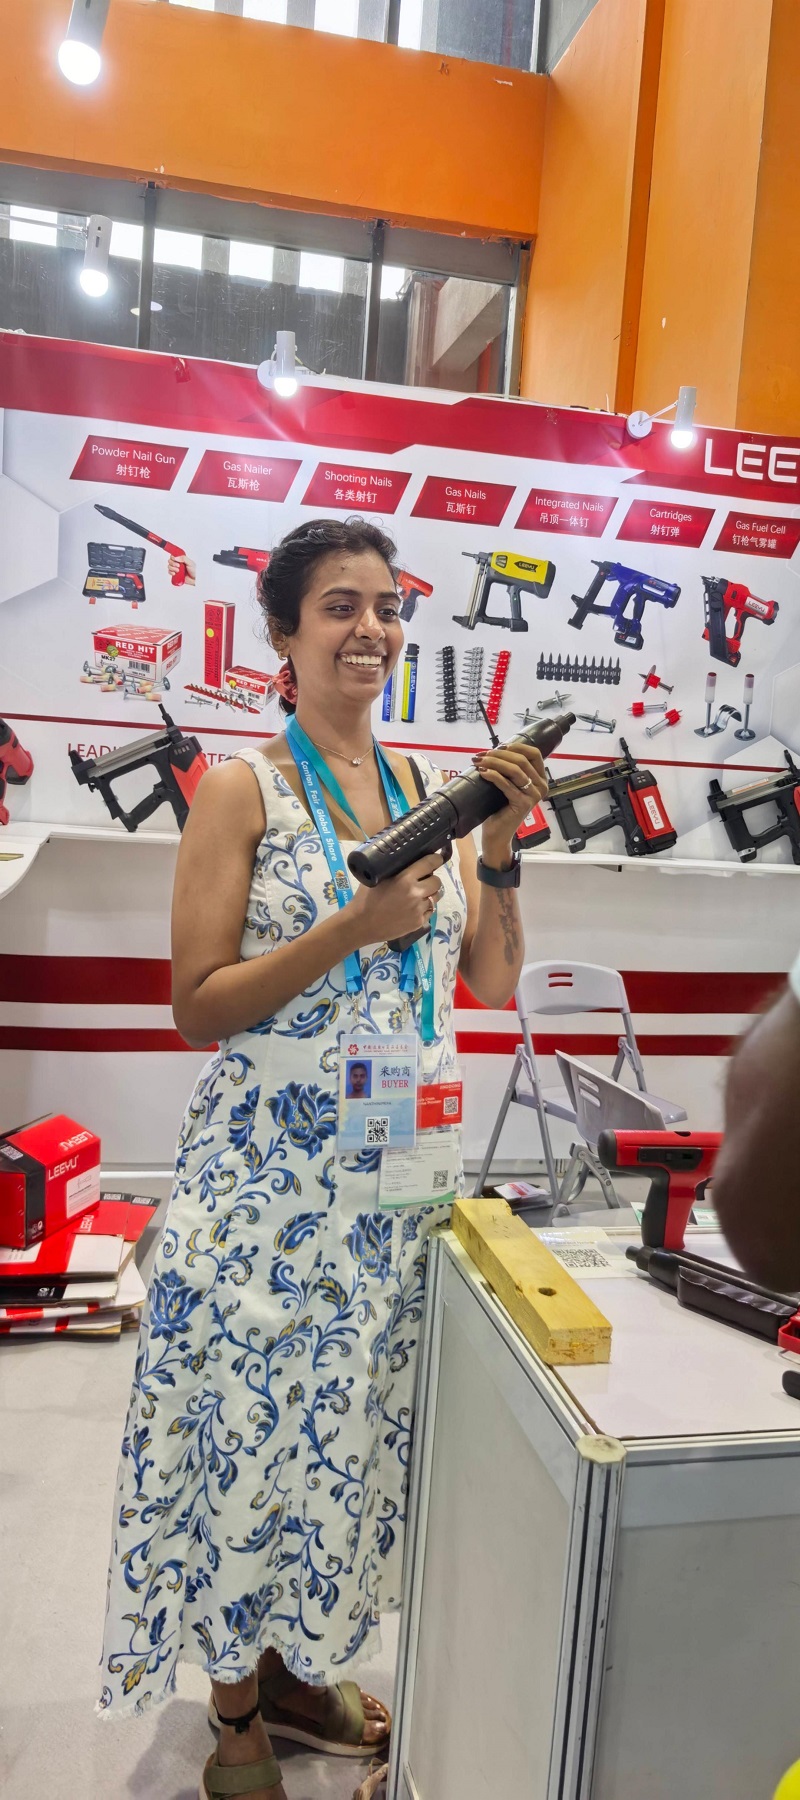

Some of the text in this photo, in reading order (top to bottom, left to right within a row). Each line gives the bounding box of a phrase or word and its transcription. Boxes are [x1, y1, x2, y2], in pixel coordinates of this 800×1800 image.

[91, 444, 176, 465] Powder Nail Gun
[704, 438, 800, 484] LEE
[115, 463, 151, 479] 射钉枪
[223, 460, 273, 476] Gas Nailer
[226, 477, 261, 492] 瓦斯枪
[324, 470, 393, 488] Shooting Nails
[333, 488, 378, 503] 各类射钉
[445, 486, 487, 501] Gas Nails
[445, 501, 477, 516] 瓦斯钉
[535, 496, 604, 512] Integrated Nails
[539, 513, 589, 528] 吊顶一体钉
[649, 508, 692, 523] Cartridges
[650, 524, 680, 538] 射钉弹
[735, 520, 786, 535] Gas Fuel Cell
[732, 534, 777, 549] 钉枪气雾罐
[115, 640, 134, 651] RED
[138, 644, 155, 654] HIT
[300, 760, 338, 862] Canton Fair Global Share
[380, 1065, 411, 1077] 采购商
[381, 1079, 409, 1089] BUYER
[48, 1157, 78, 1181] LEEYU
